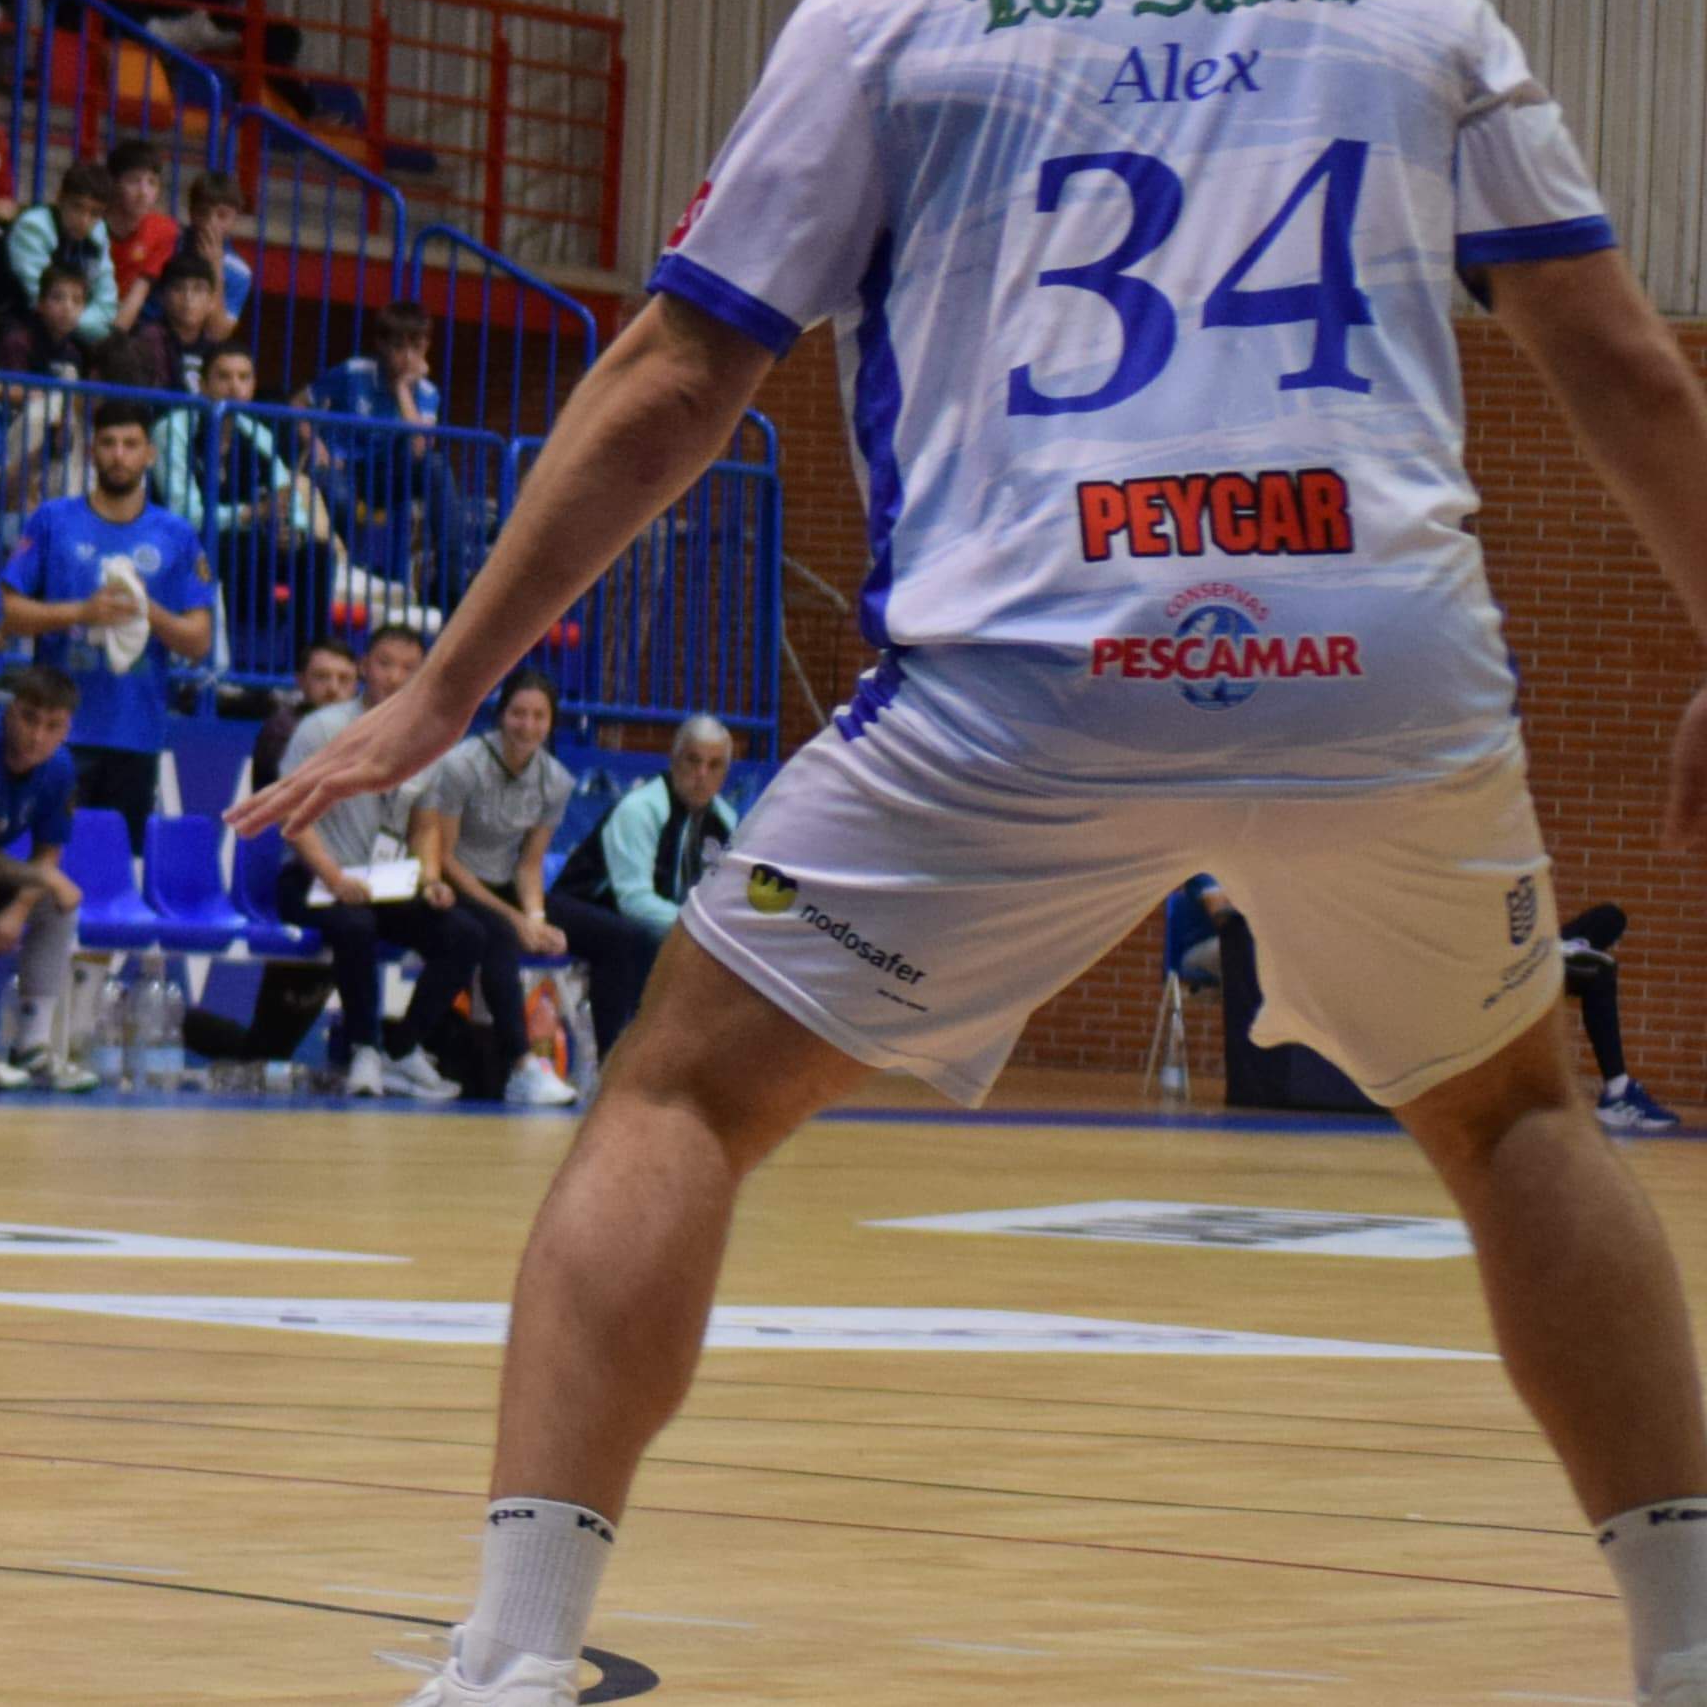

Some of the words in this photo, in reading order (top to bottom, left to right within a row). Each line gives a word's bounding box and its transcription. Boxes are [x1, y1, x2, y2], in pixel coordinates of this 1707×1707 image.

[1098, 41, 1263, 105] Alex
[1006, 138, 1377, 416] 34
[1076, 467, 1355, 562] PEYCAR
[1090, 635, 1364, 681] PESCAMAR
[800, 903, 926, 986] nodosafer
